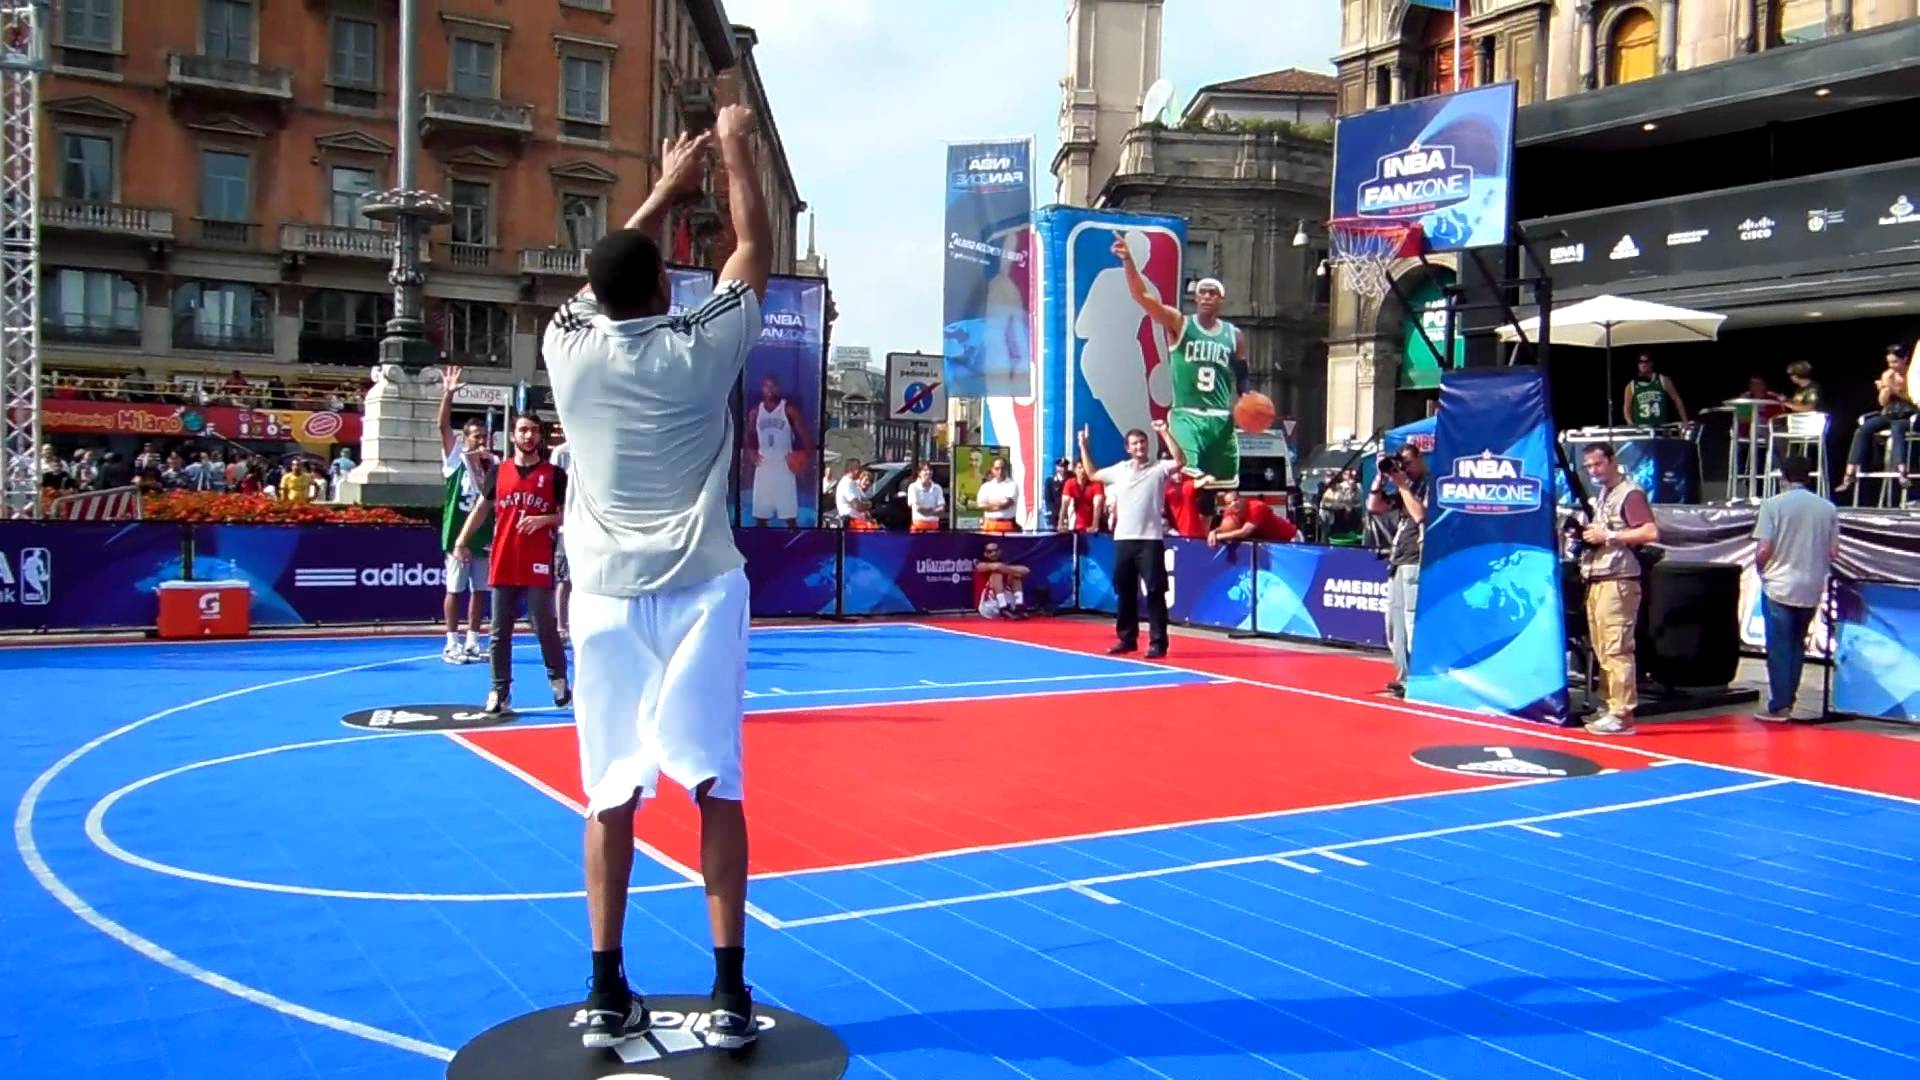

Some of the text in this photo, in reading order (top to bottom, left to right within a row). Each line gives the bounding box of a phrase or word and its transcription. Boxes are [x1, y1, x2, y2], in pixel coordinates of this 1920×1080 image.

[1364, 174, 1465, 206] FANZONE
[1740, 228, 1772, 241] CISCO
[1184, 340, 1231, 367] CELTICS
[1197, 366, 1216, 392] 9
[458, 388, 502, 401] Change
[1639, 402, 1661, 417] 34
[1442, 483, 1533, 501] FANZONE
[1324, 578, 1389, 598] AMERIC
[1323, 593, 1389, 613] EXPRES
